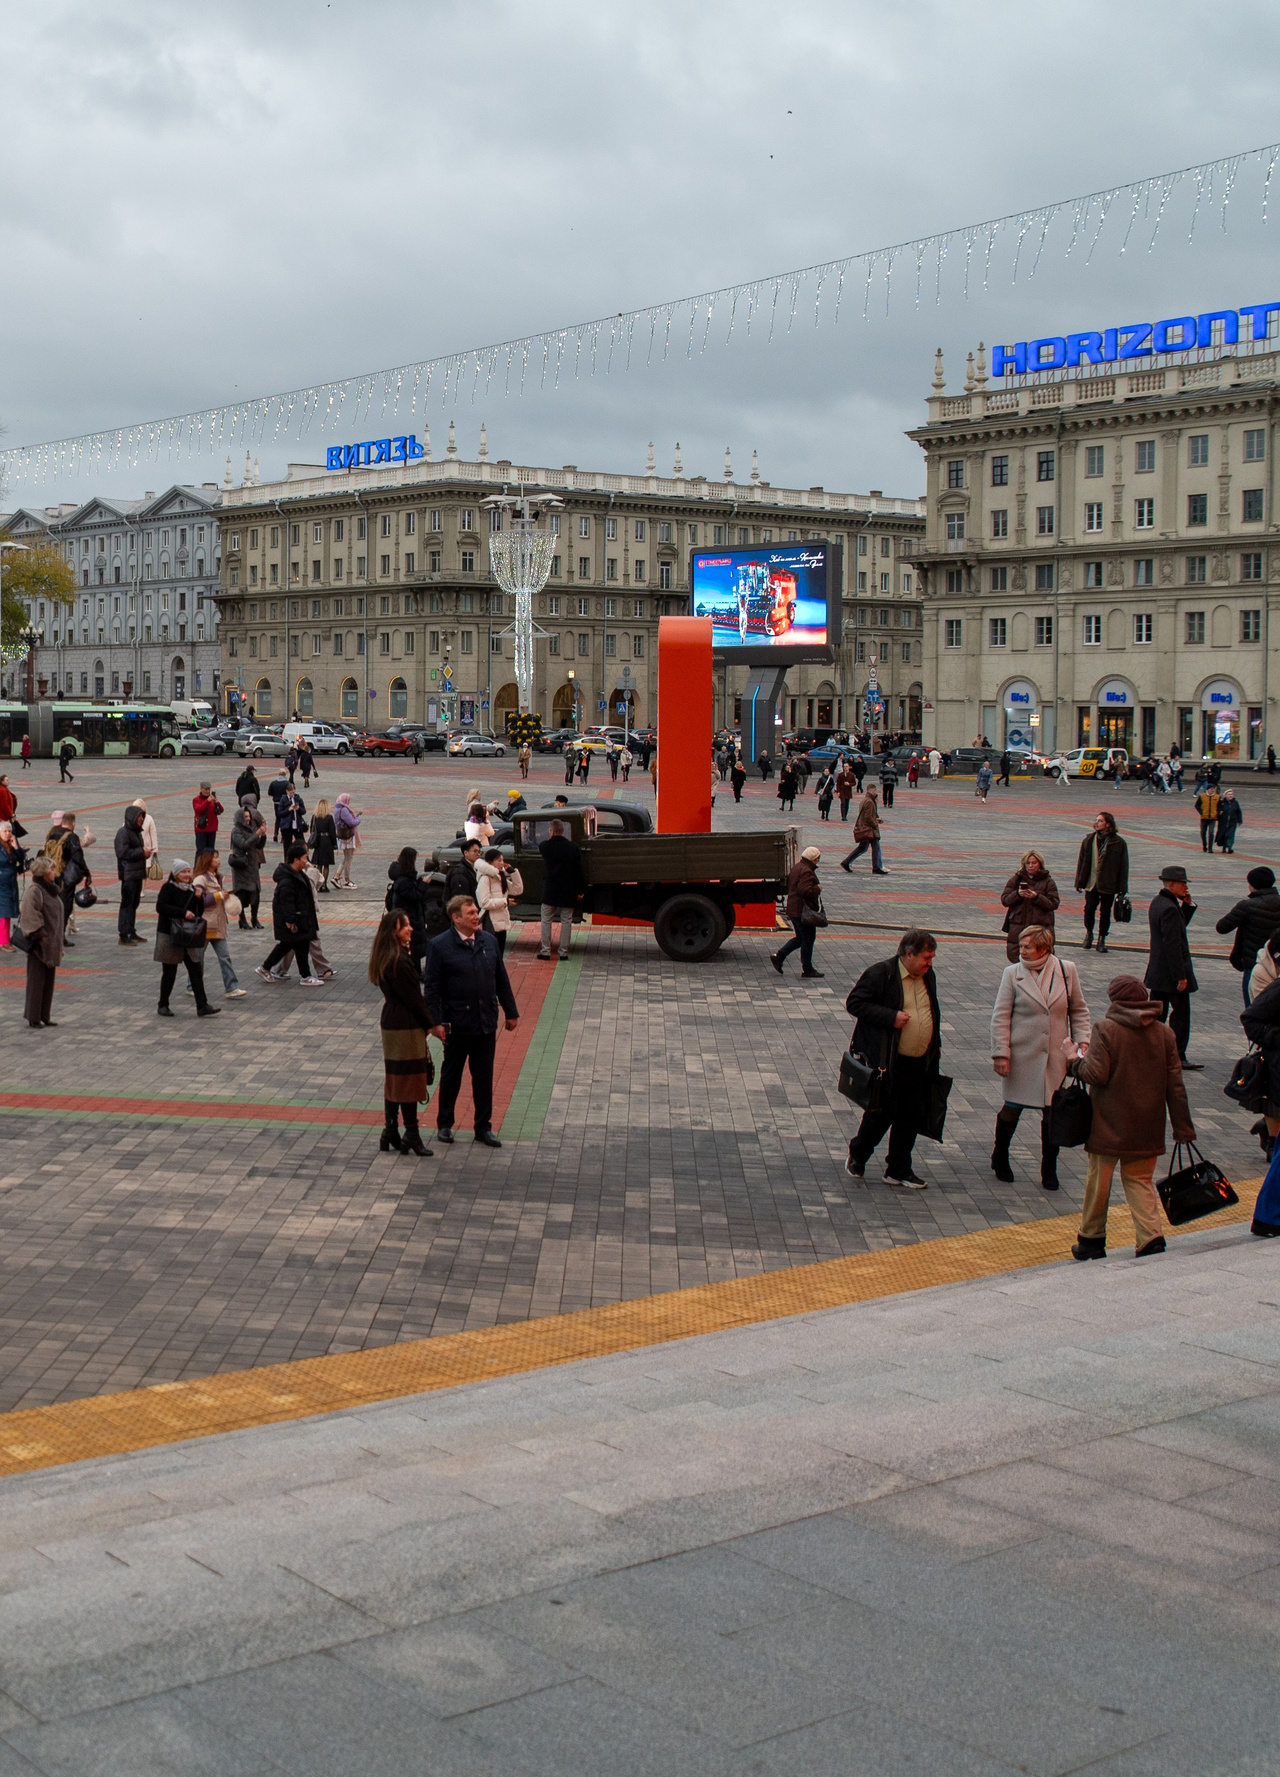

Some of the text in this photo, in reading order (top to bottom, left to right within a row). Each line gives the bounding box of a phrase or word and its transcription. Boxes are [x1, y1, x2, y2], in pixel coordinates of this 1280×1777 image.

[992, 302, 1280, 377] HORIZONT
[327, 435, 425, 470] ВИТЯЗЬ
[1106, 692, 1126, 703] life:)
[1211, 692, 1233, 704] life:)
